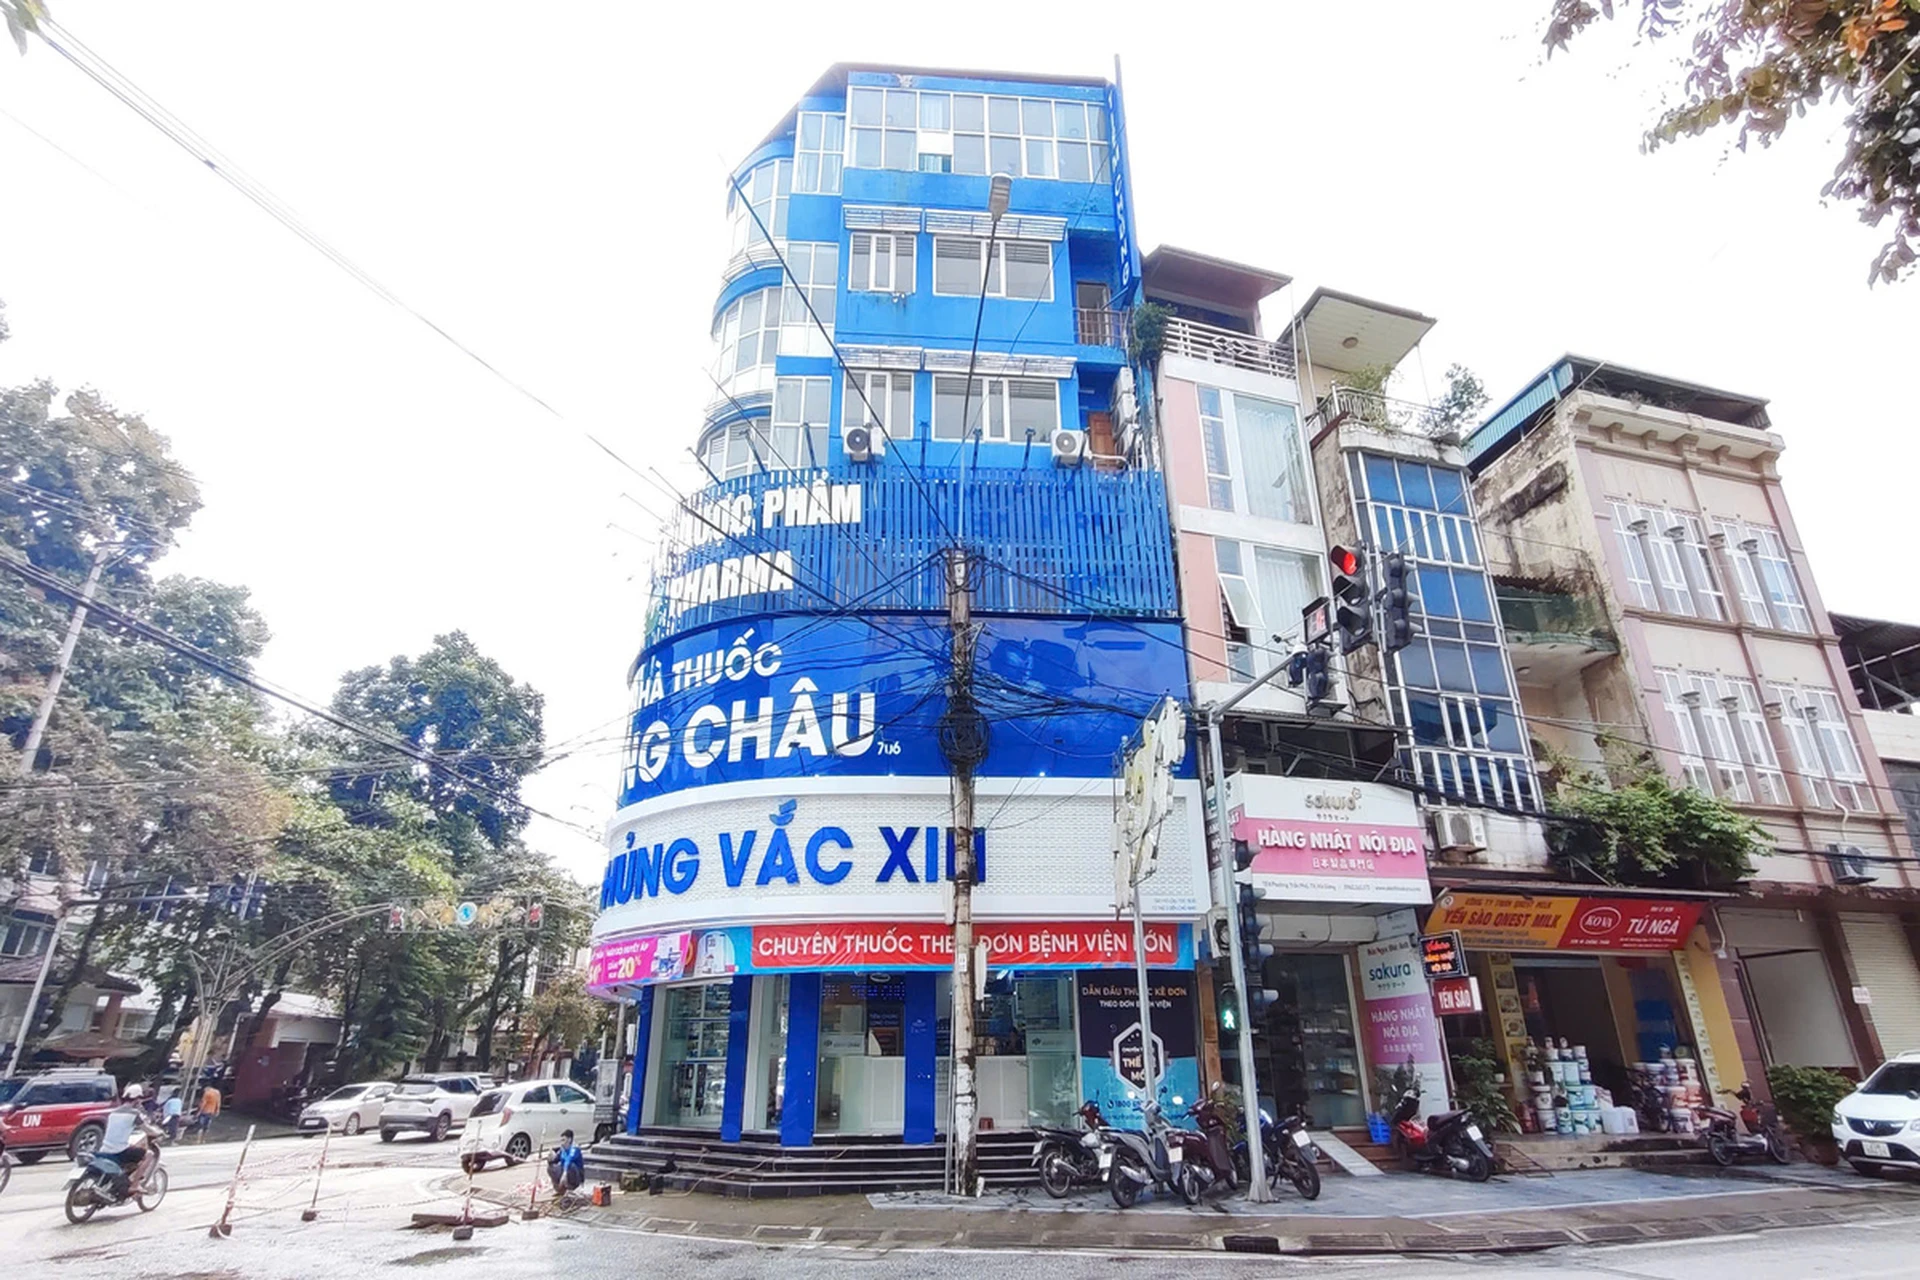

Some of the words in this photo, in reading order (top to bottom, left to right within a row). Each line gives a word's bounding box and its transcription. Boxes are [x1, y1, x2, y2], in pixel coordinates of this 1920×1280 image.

[762, 470, 862, 529] PHẨM
[668, 551, 793, 617] PHARMA
[672, 628, 783, 694] THUỐC
[683, 677, 876, 770] CHÂU
[1304, 789, 1357, 811] sakura
[601, 831, 700, 910] HỦNG
[718, 798, 854, 887] VẮC
[1257, 824, 1307, 849] HÀNG
[1310, 829, 1352, 854] NHẬT
[1358, 830, 1388, 857] NỘI
[1389, 836, 1418, 858] ĐỊA
[1444, 906, 1468, 925] YẾN
[1468, 908, 1493, 926] SÀO
[1531, 914, 1562, 929] MILK
[1627, 914, 1649, 935] TÚ
[759, 931, 837, 956] CHUYÊN
[844, 927, 913, 954] THUỐC
[920, 935, 955, 954] THE
[979, 932, 1023, 953] ĐƠN
[1028, 929, 1079, 958] BỆNH
[1085, 928, 1127, 957] VIỆN
[1134, 929, 1173, 953] ỚN
[1369, 962, 1412, 981] sakura
[1123, 986, 1153, 996] THC
[1437, 985, 1455, 1009] YẾN
[1455, 985, 1471, 1009] SÀO
[22, 1114, 42, 1127] UN
